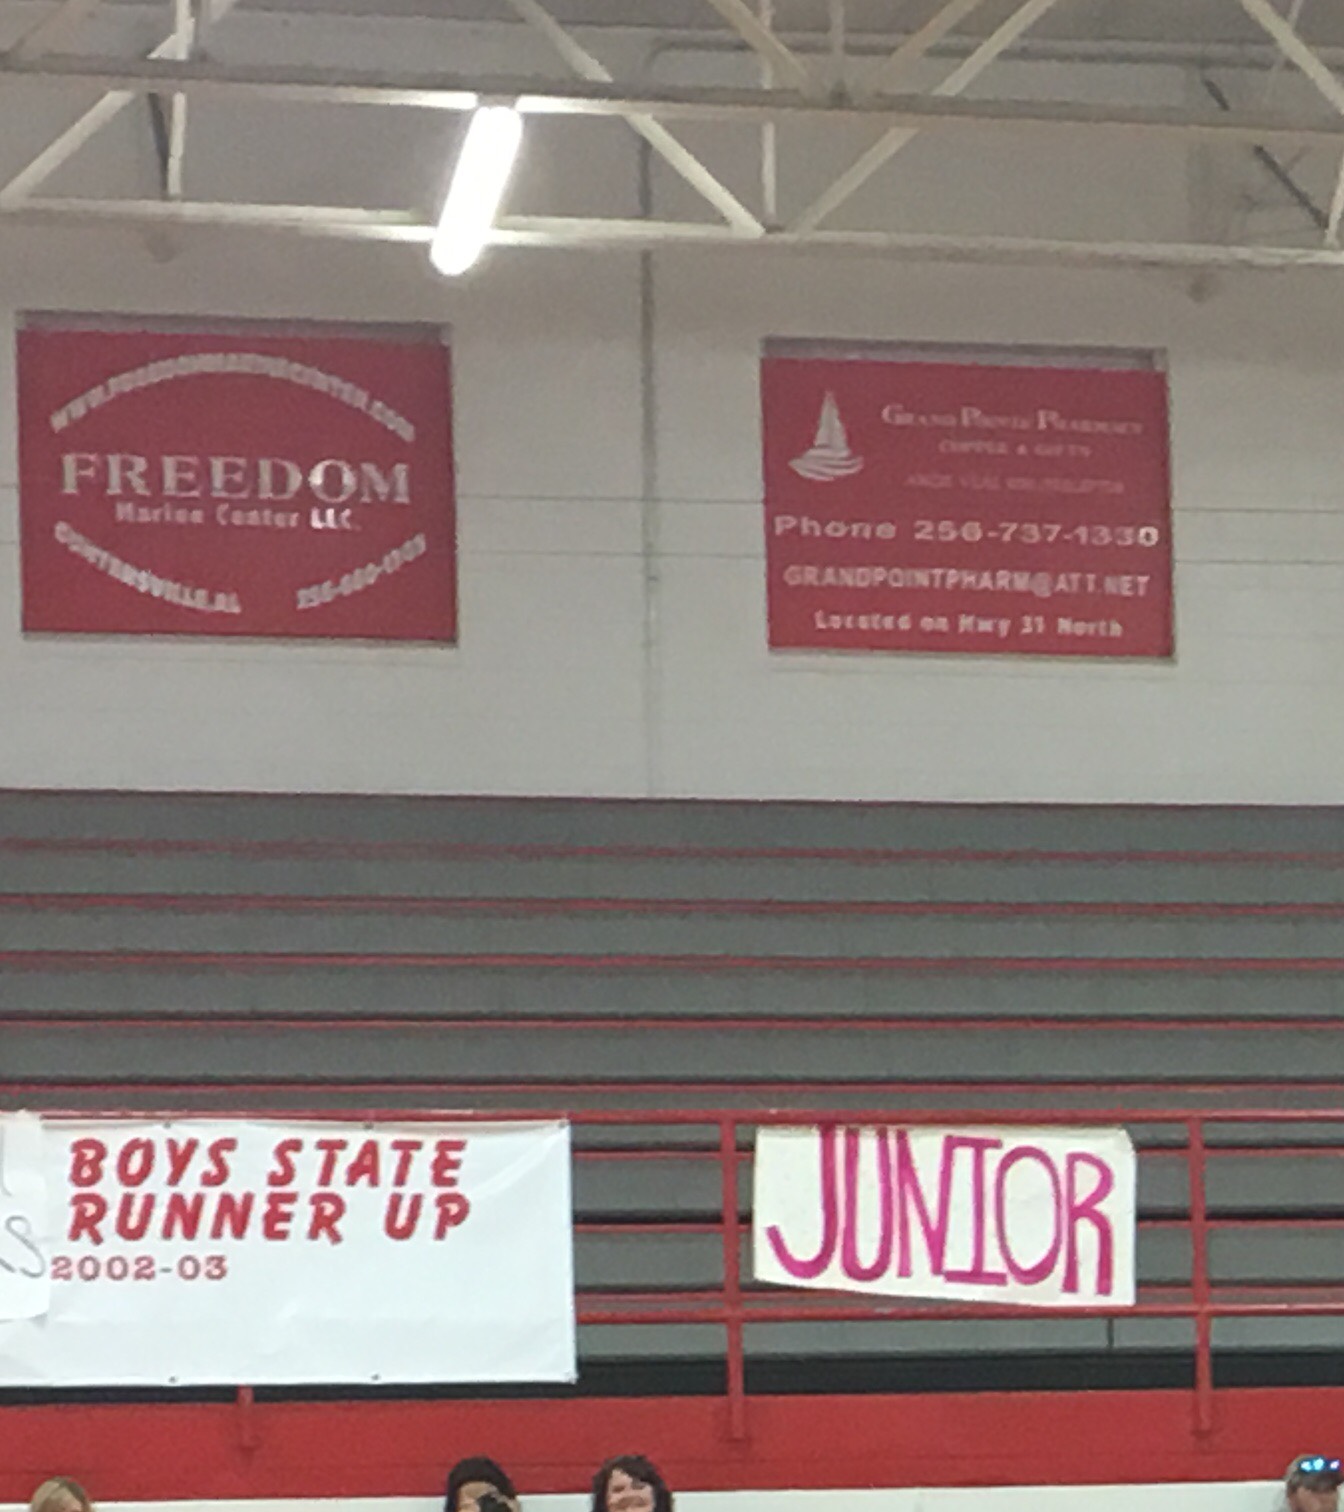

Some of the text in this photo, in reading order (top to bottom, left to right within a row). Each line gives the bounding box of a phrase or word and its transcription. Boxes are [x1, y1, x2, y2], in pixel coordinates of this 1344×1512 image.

[60, 452, 412, 504] FREEDOM
[216, 504, 299, 528] Center
[773, 514, 897, 540] Phone
[782, 564, 1151, 598] GRANDPOINTPHARM@ATT.NET
[814, 609, 1124, 638] Located on Hwy 31 North
[68, 1137, 469, 1189] BOYS STATE
[67, 1192, 471, 1245] RUNNER UP
[766, 1122, 1116, 1297] JUNIOR
[50, 1255, 229, 1282] 2002-03
